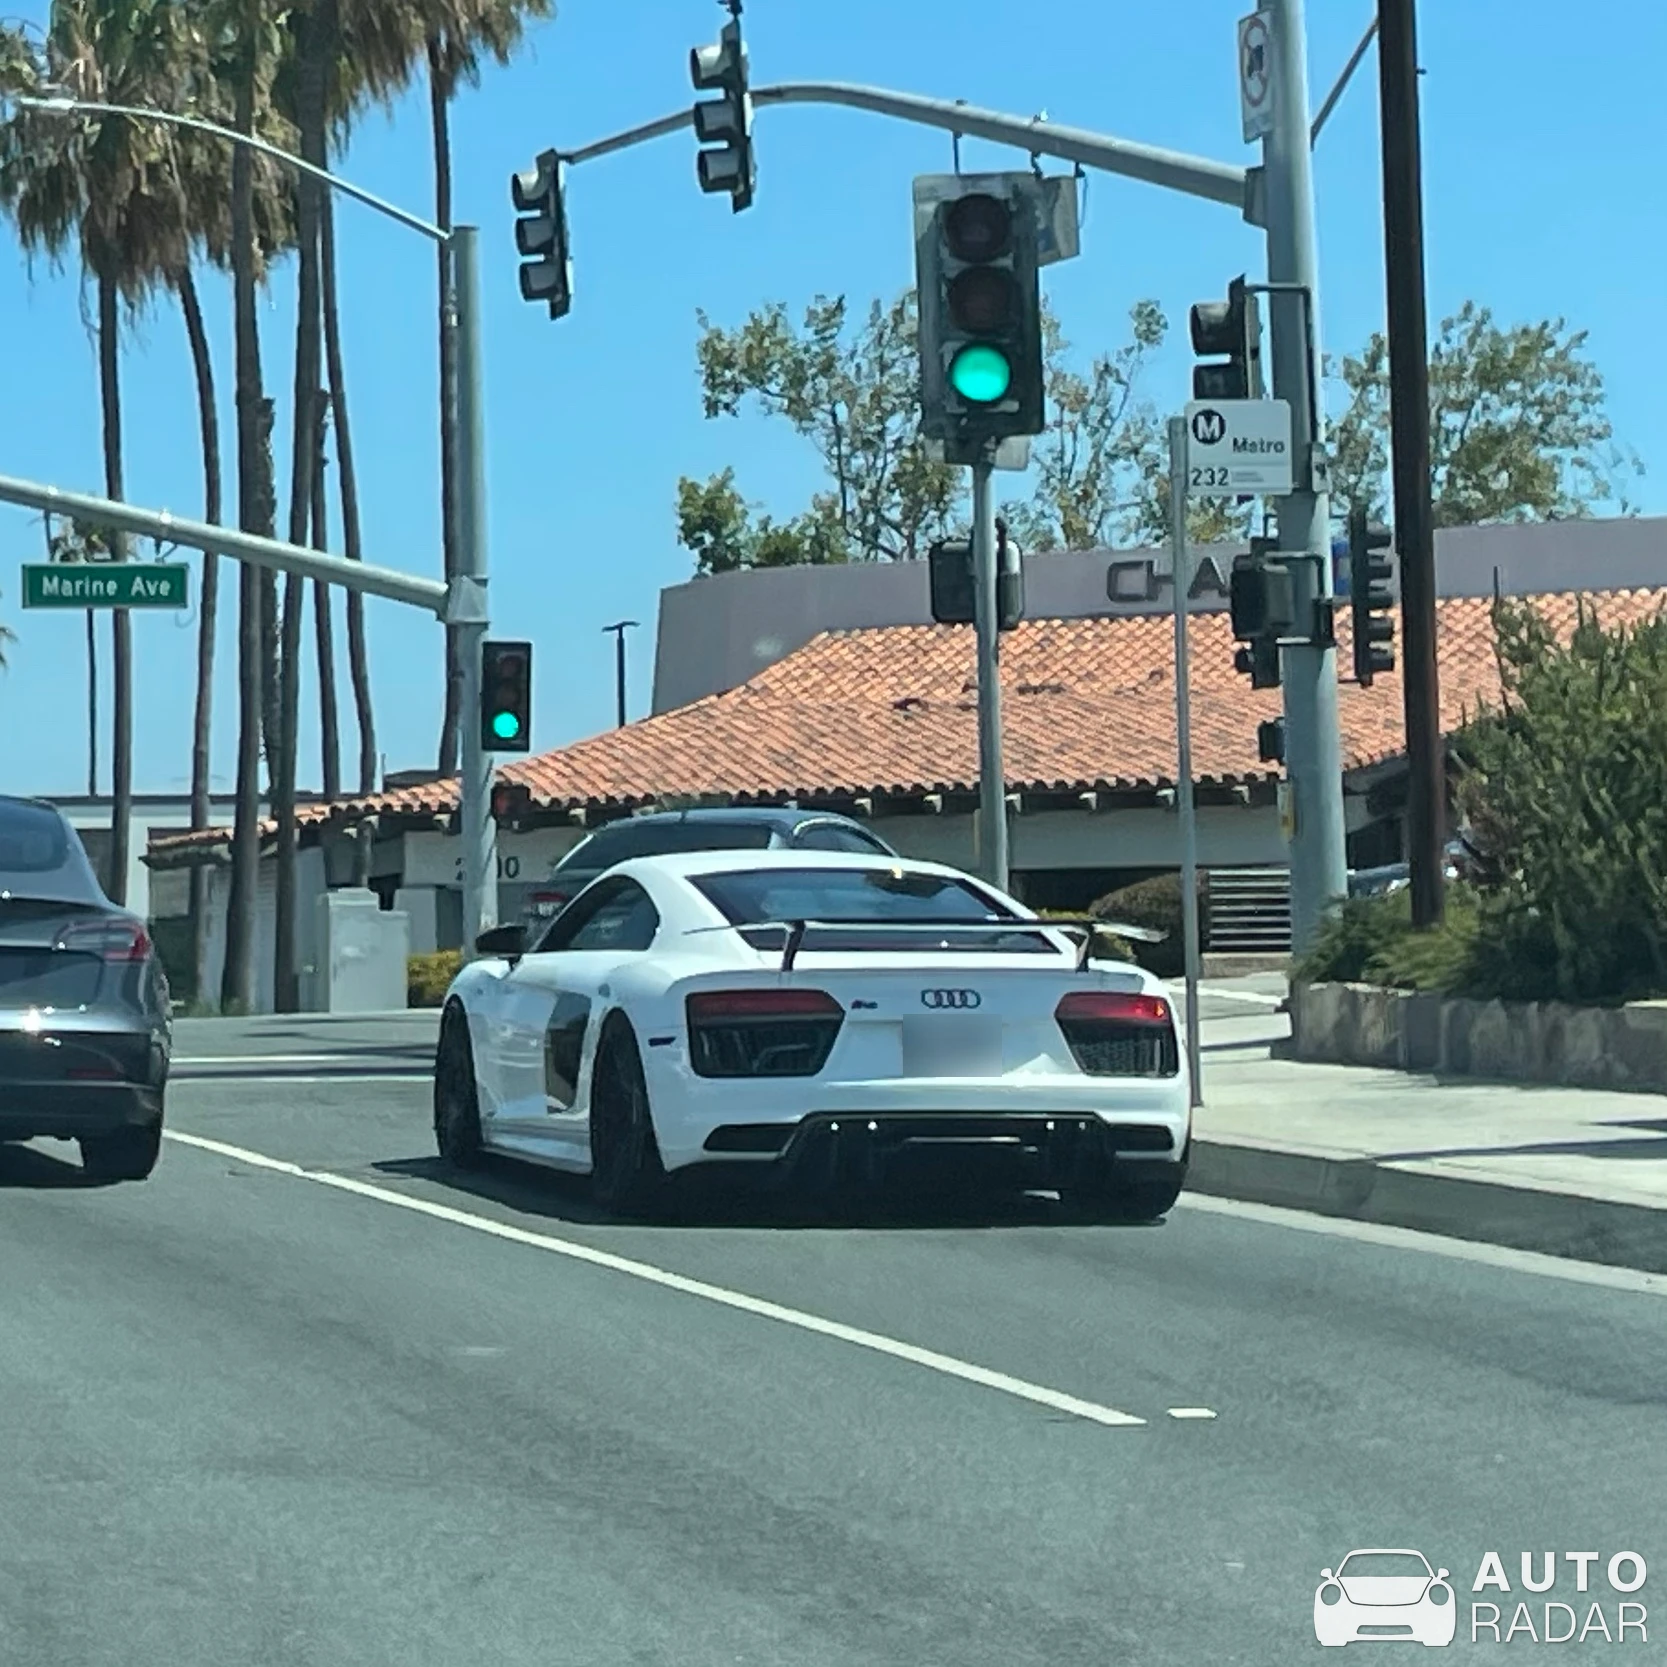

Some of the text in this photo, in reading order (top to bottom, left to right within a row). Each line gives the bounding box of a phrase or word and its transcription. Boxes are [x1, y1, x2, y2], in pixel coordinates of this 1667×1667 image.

[1196, 413, 1222, 442] M
[1232, 437, 1285, 453] Metro
[1191, 466, 1229, 486] 232
[42, 575, 171, 597] Marine Ave
